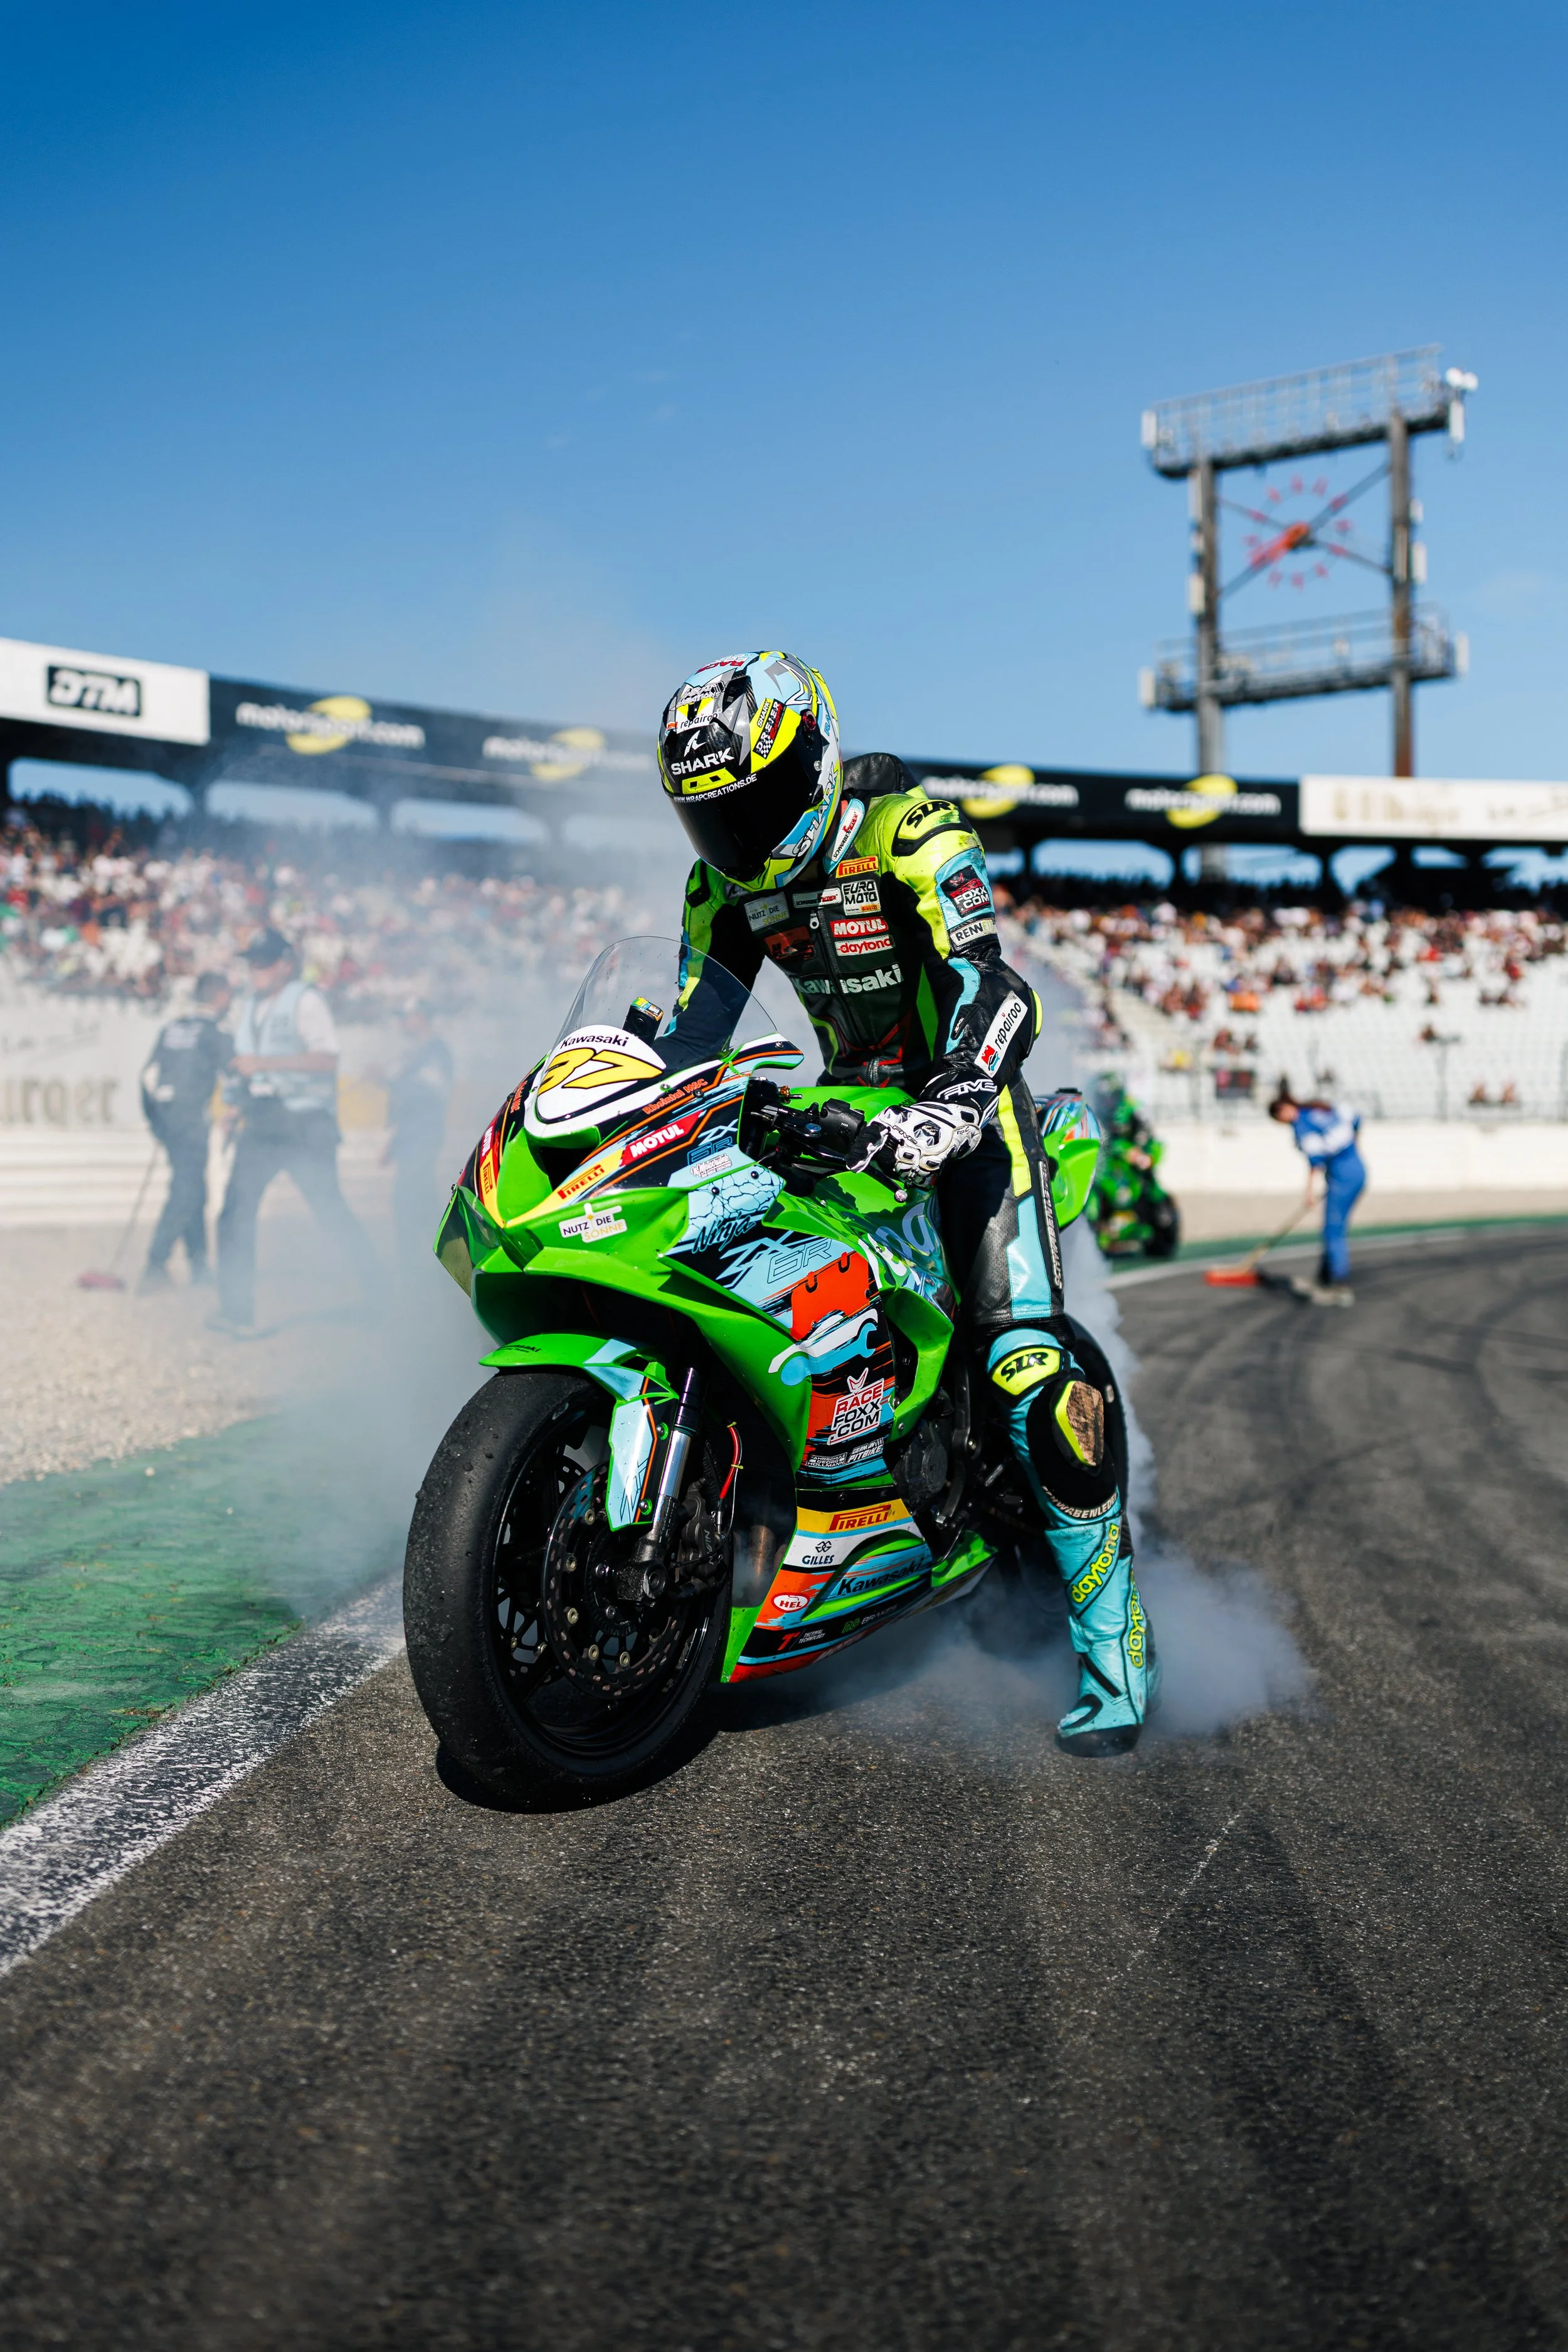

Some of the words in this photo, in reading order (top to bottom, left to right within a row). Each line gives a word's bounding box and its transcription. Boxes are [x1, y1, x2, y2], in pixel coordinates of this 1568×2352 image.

[51, 669, 138, 715] DTM
[757, 701, 770, 728] SHARK
[670, 747, 734, 775] SHARK
[673, 773, 758, 803] WWW.WRAPCREATIONS.DE
[792, 761, 838, 857] SHARK
[839, 857, 878, 876] PIRELLI
[843, 881, 875, 895] EURO
[845, 892, 877, 905] MOTO
[953, 886, 987, 904] FOXX
[748, 910, 766, 921] NUTZ
[769, 905, 780, 914] DIE
[960, 894, 990, 911] .COM
[763, 911, 788, 925] SONNE
[834, 919, 886, 935] MOTUL
[995, 1002, 1022, 1050] repairoo
[560, 1035, 629, 1049] Kawasaki
[642, 1089, 686, 1115] Rheintal
[683, 1078, 708, 1094] MSC
[630, 1124, 685, 1158] MOTUL
[557, 1164, 605, 1200] PIRELLI
[563, 1222, 590, 1236] NUTZ
[596, 1216, 612, 1226] DIE
[584, 1222, 623, 1241] SONNE
[691, 1211, 756, 1254] Ninja
[833, 1398, 881, 1429] FOXX
[835, 1387, 882, 1416] RACE
[830, 1414, 879, 1441] .COM
[847, 1444, 883, 1463] PITBIKE
[829, 1504, 892, 1531] PIRELLI
[802, 1555, 835, 1565] GILLES
[1071, 1523, 1121, 1604] daytona
[837, 1558, 925, 1596] Kawasaki
[779, 1599, 802, 1609] HEL
